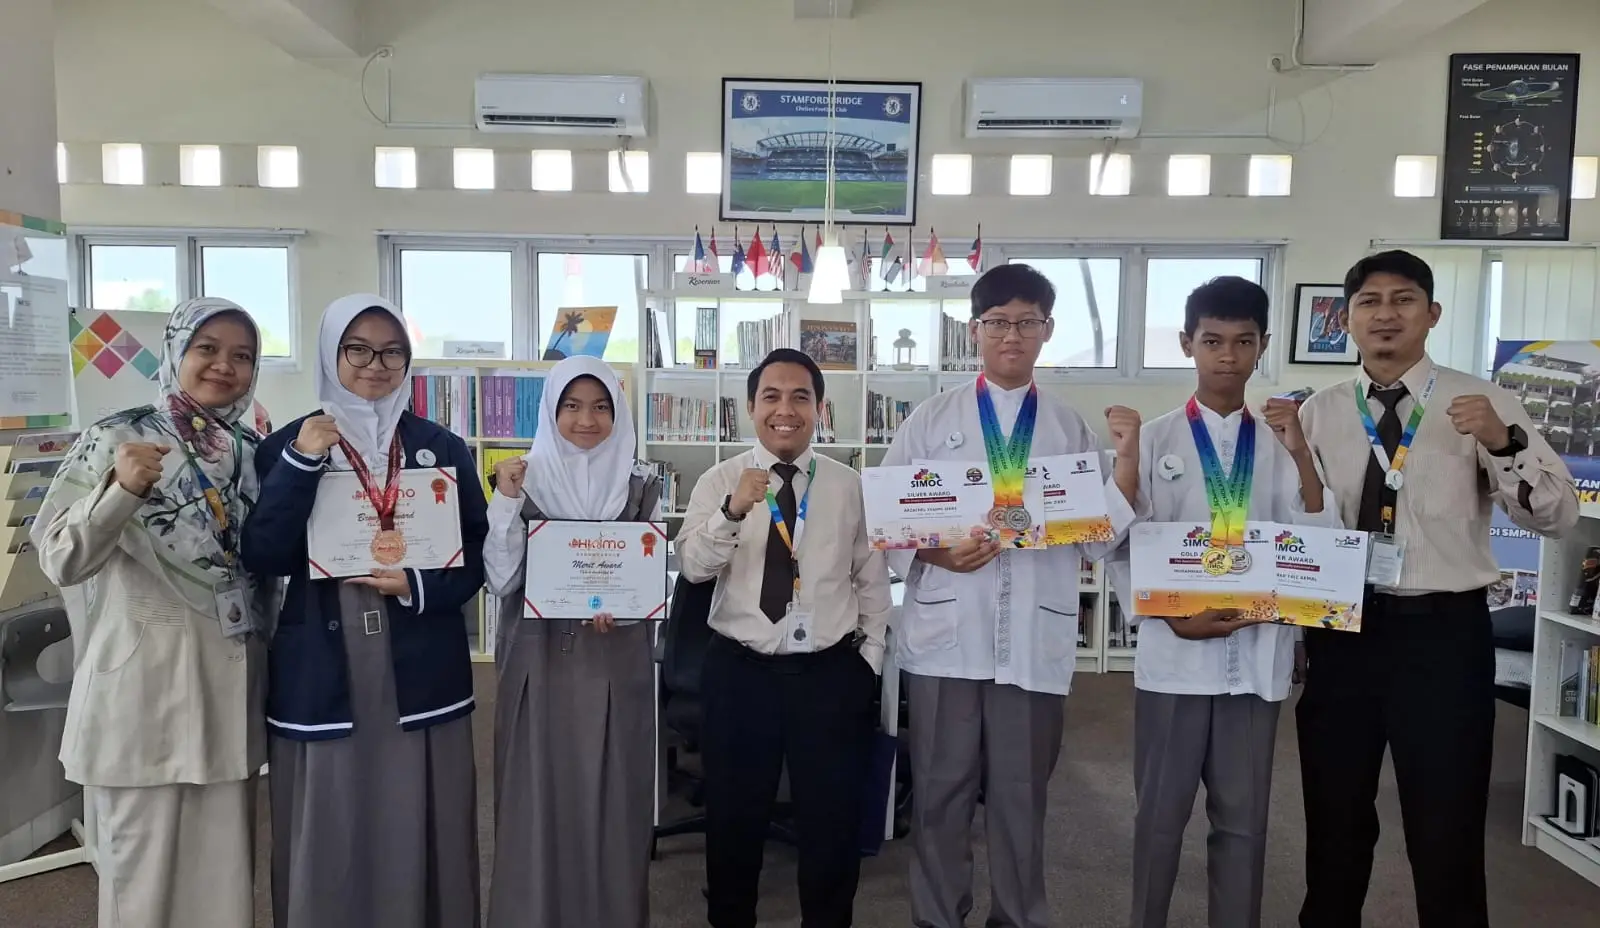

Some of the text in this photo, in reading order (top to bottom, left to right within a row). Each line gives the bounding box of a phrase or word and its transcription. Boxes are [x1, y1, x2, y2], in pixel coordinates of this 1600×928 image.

[780, 95, 829, 105] STAMFORD
[910, 479, 943, 488] SIMOC
[1274, 543, 1306, 553] IMOC
[572, 560, 624, 569] Merit Award
